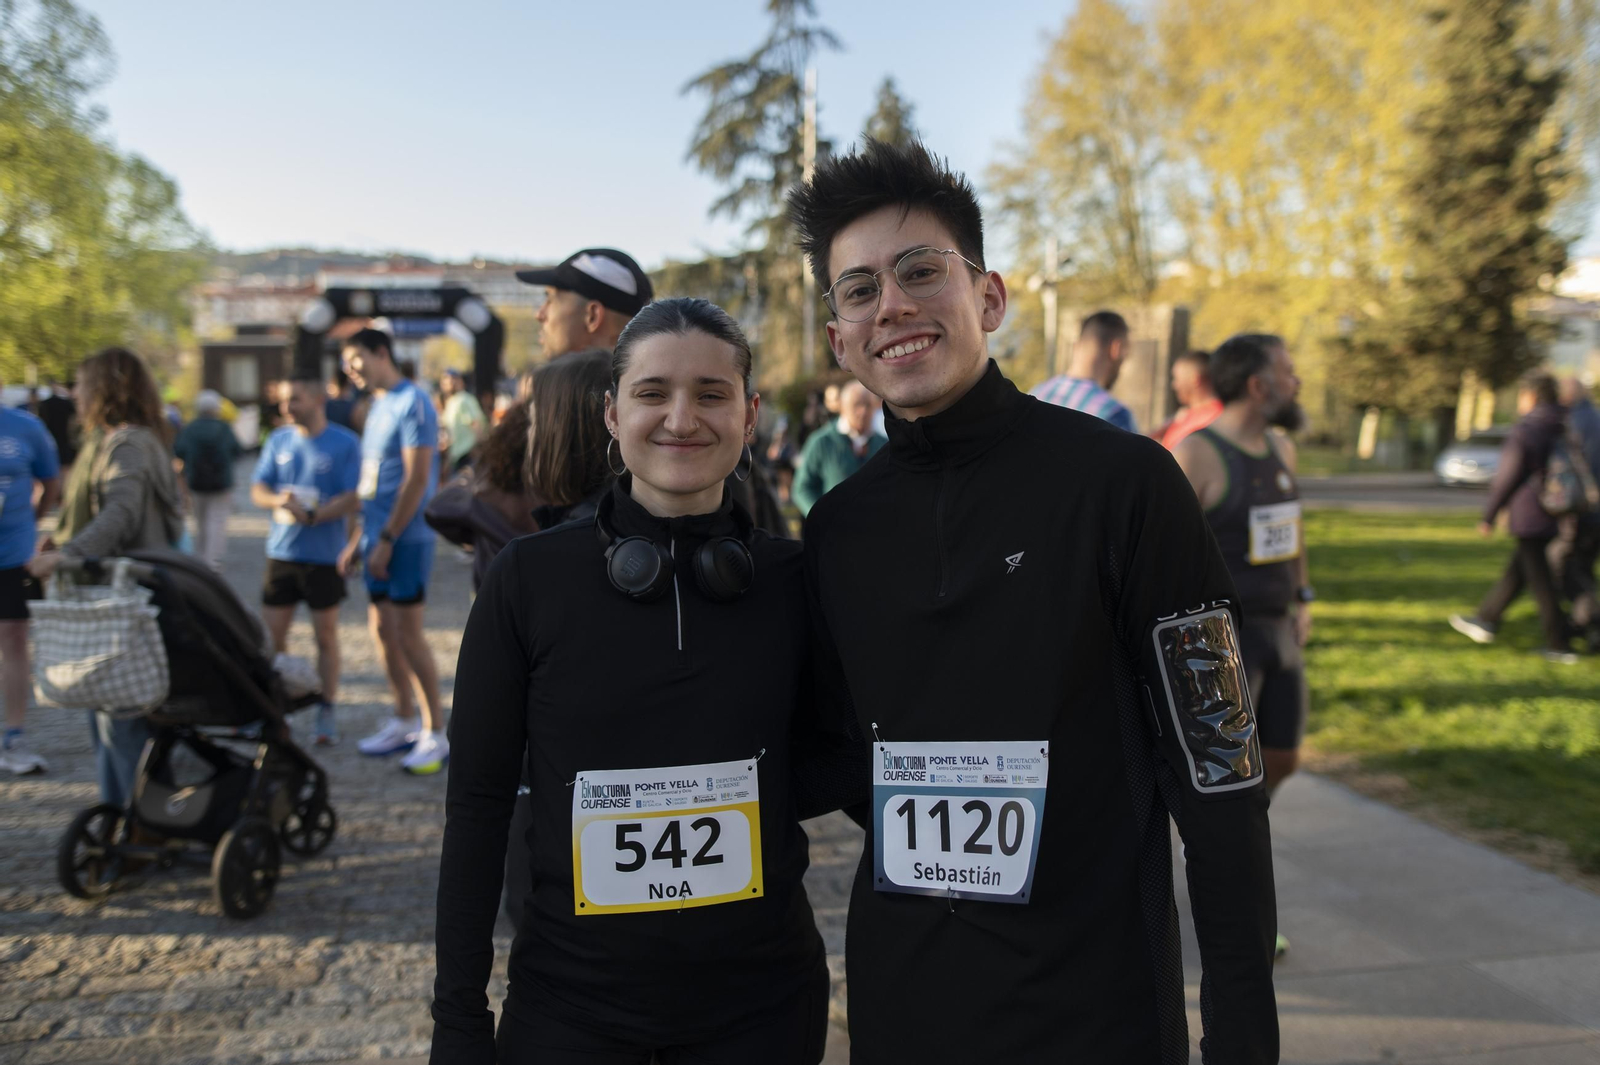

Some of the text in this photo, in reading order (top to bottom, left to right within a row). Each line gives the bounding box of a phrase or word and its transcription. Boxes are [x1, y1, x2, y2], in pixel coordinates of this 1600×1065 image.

[929, 756, 989, 765] PONTE VELLA
[715, 775, 749, 784] DEPUTACIÓN
[883, 770, 926, 781] OURENSE
[635, 780, 699, 792] PONTE VELLA
[580, 798, 631, 809] OURENSE
[896, 798, 1025, 856] 1120
[615, 817, 724, 873] 542
[913, 862, 1001, 886] Sebastián
[649, 881, 693, 899] NoA
